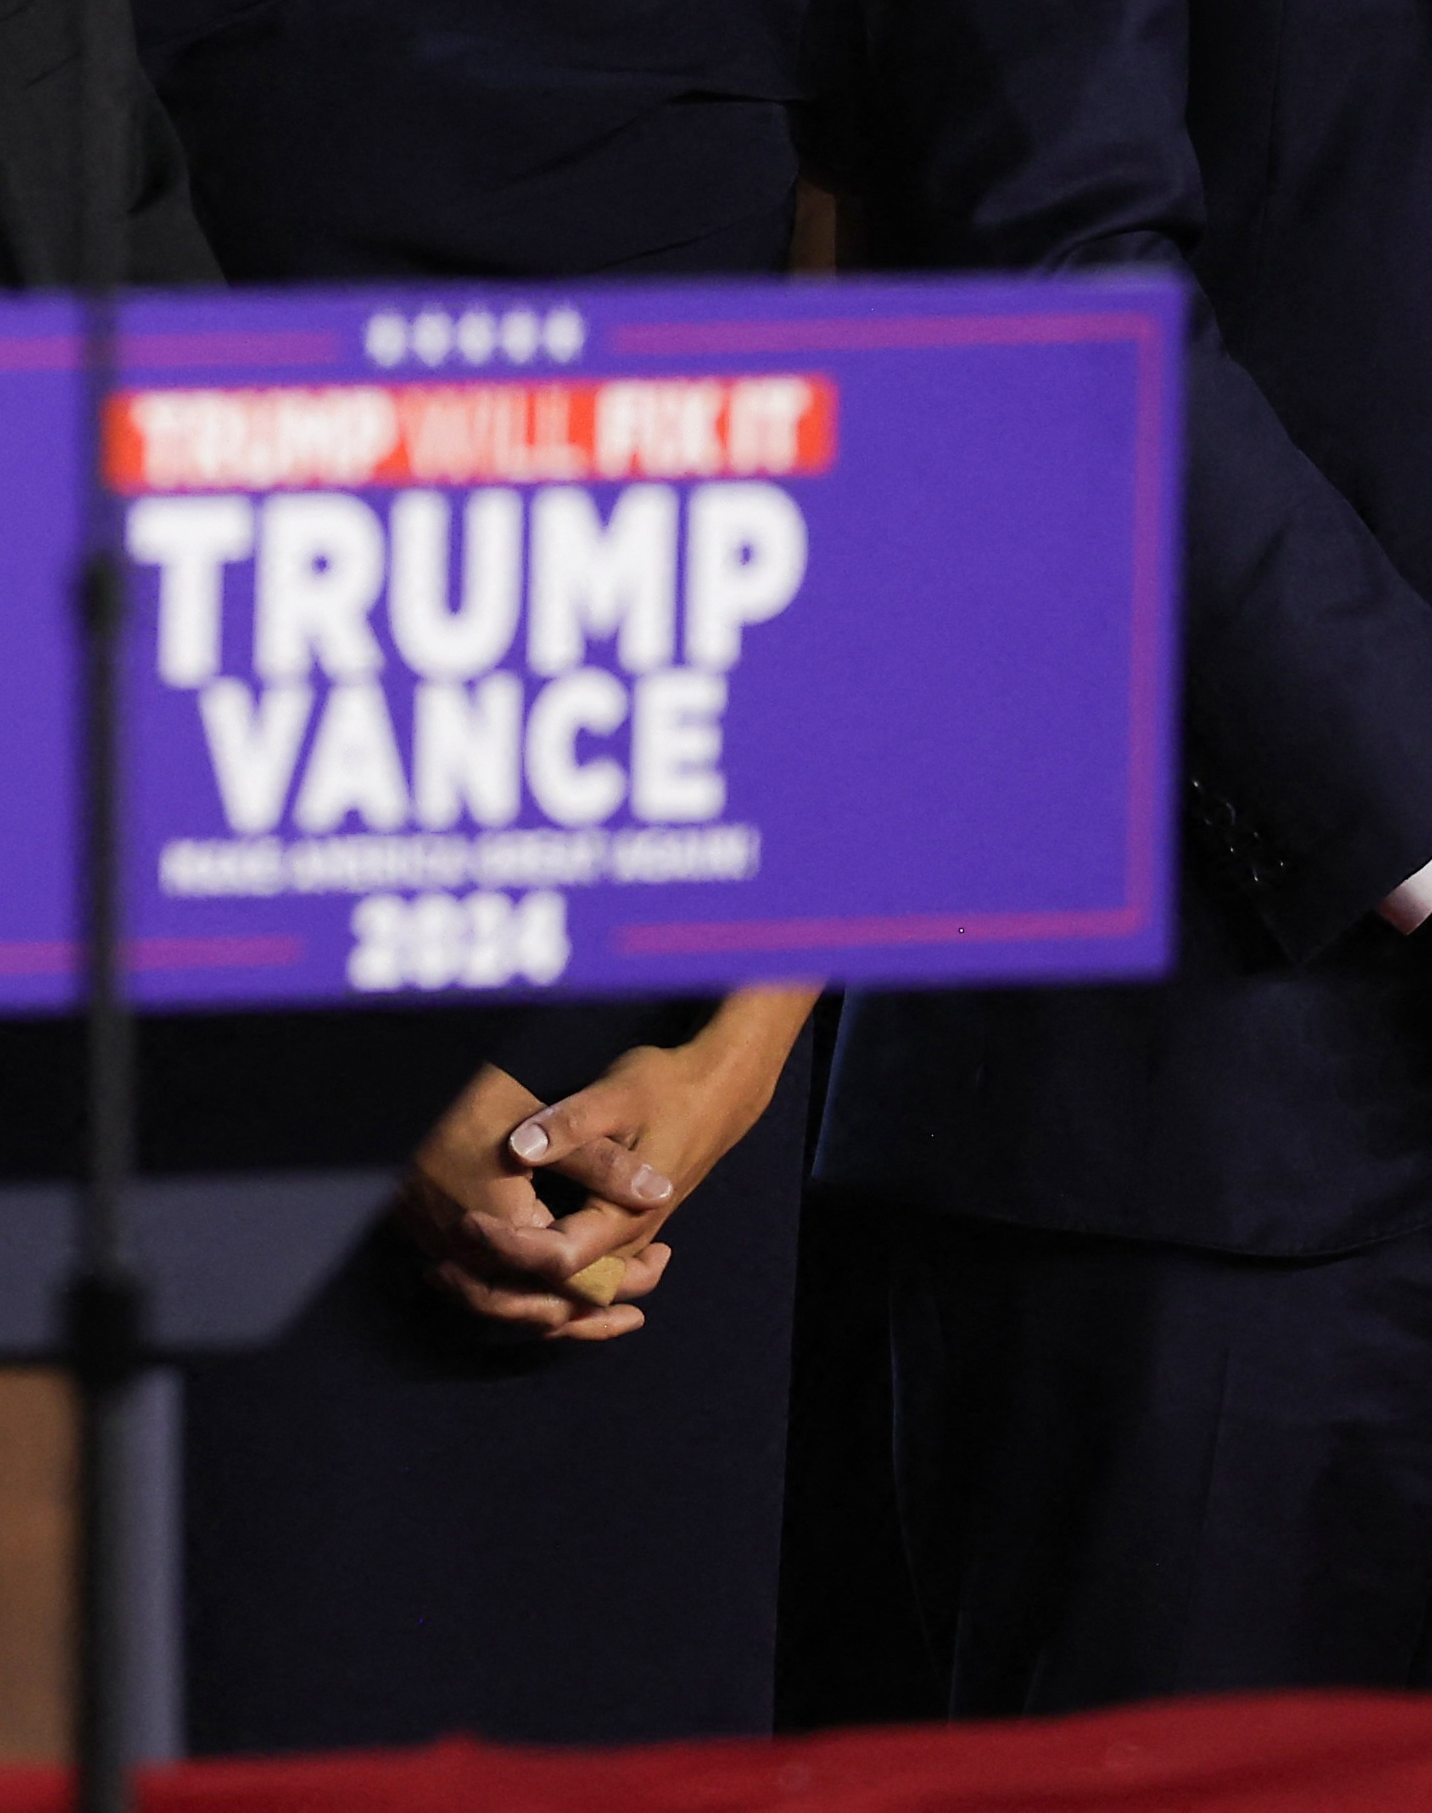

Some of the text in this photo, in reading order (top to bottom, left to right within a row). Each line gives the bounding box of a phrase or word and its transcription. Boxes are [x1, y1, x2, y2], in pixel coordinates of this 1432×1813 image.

[132, 372, 814, 489] TRUMP WILL FIX IT
[126, 481, 811, 689] TRUMP
[197, 666, 728, 834] VANCE
[347, 888, 572, 991] 2024
